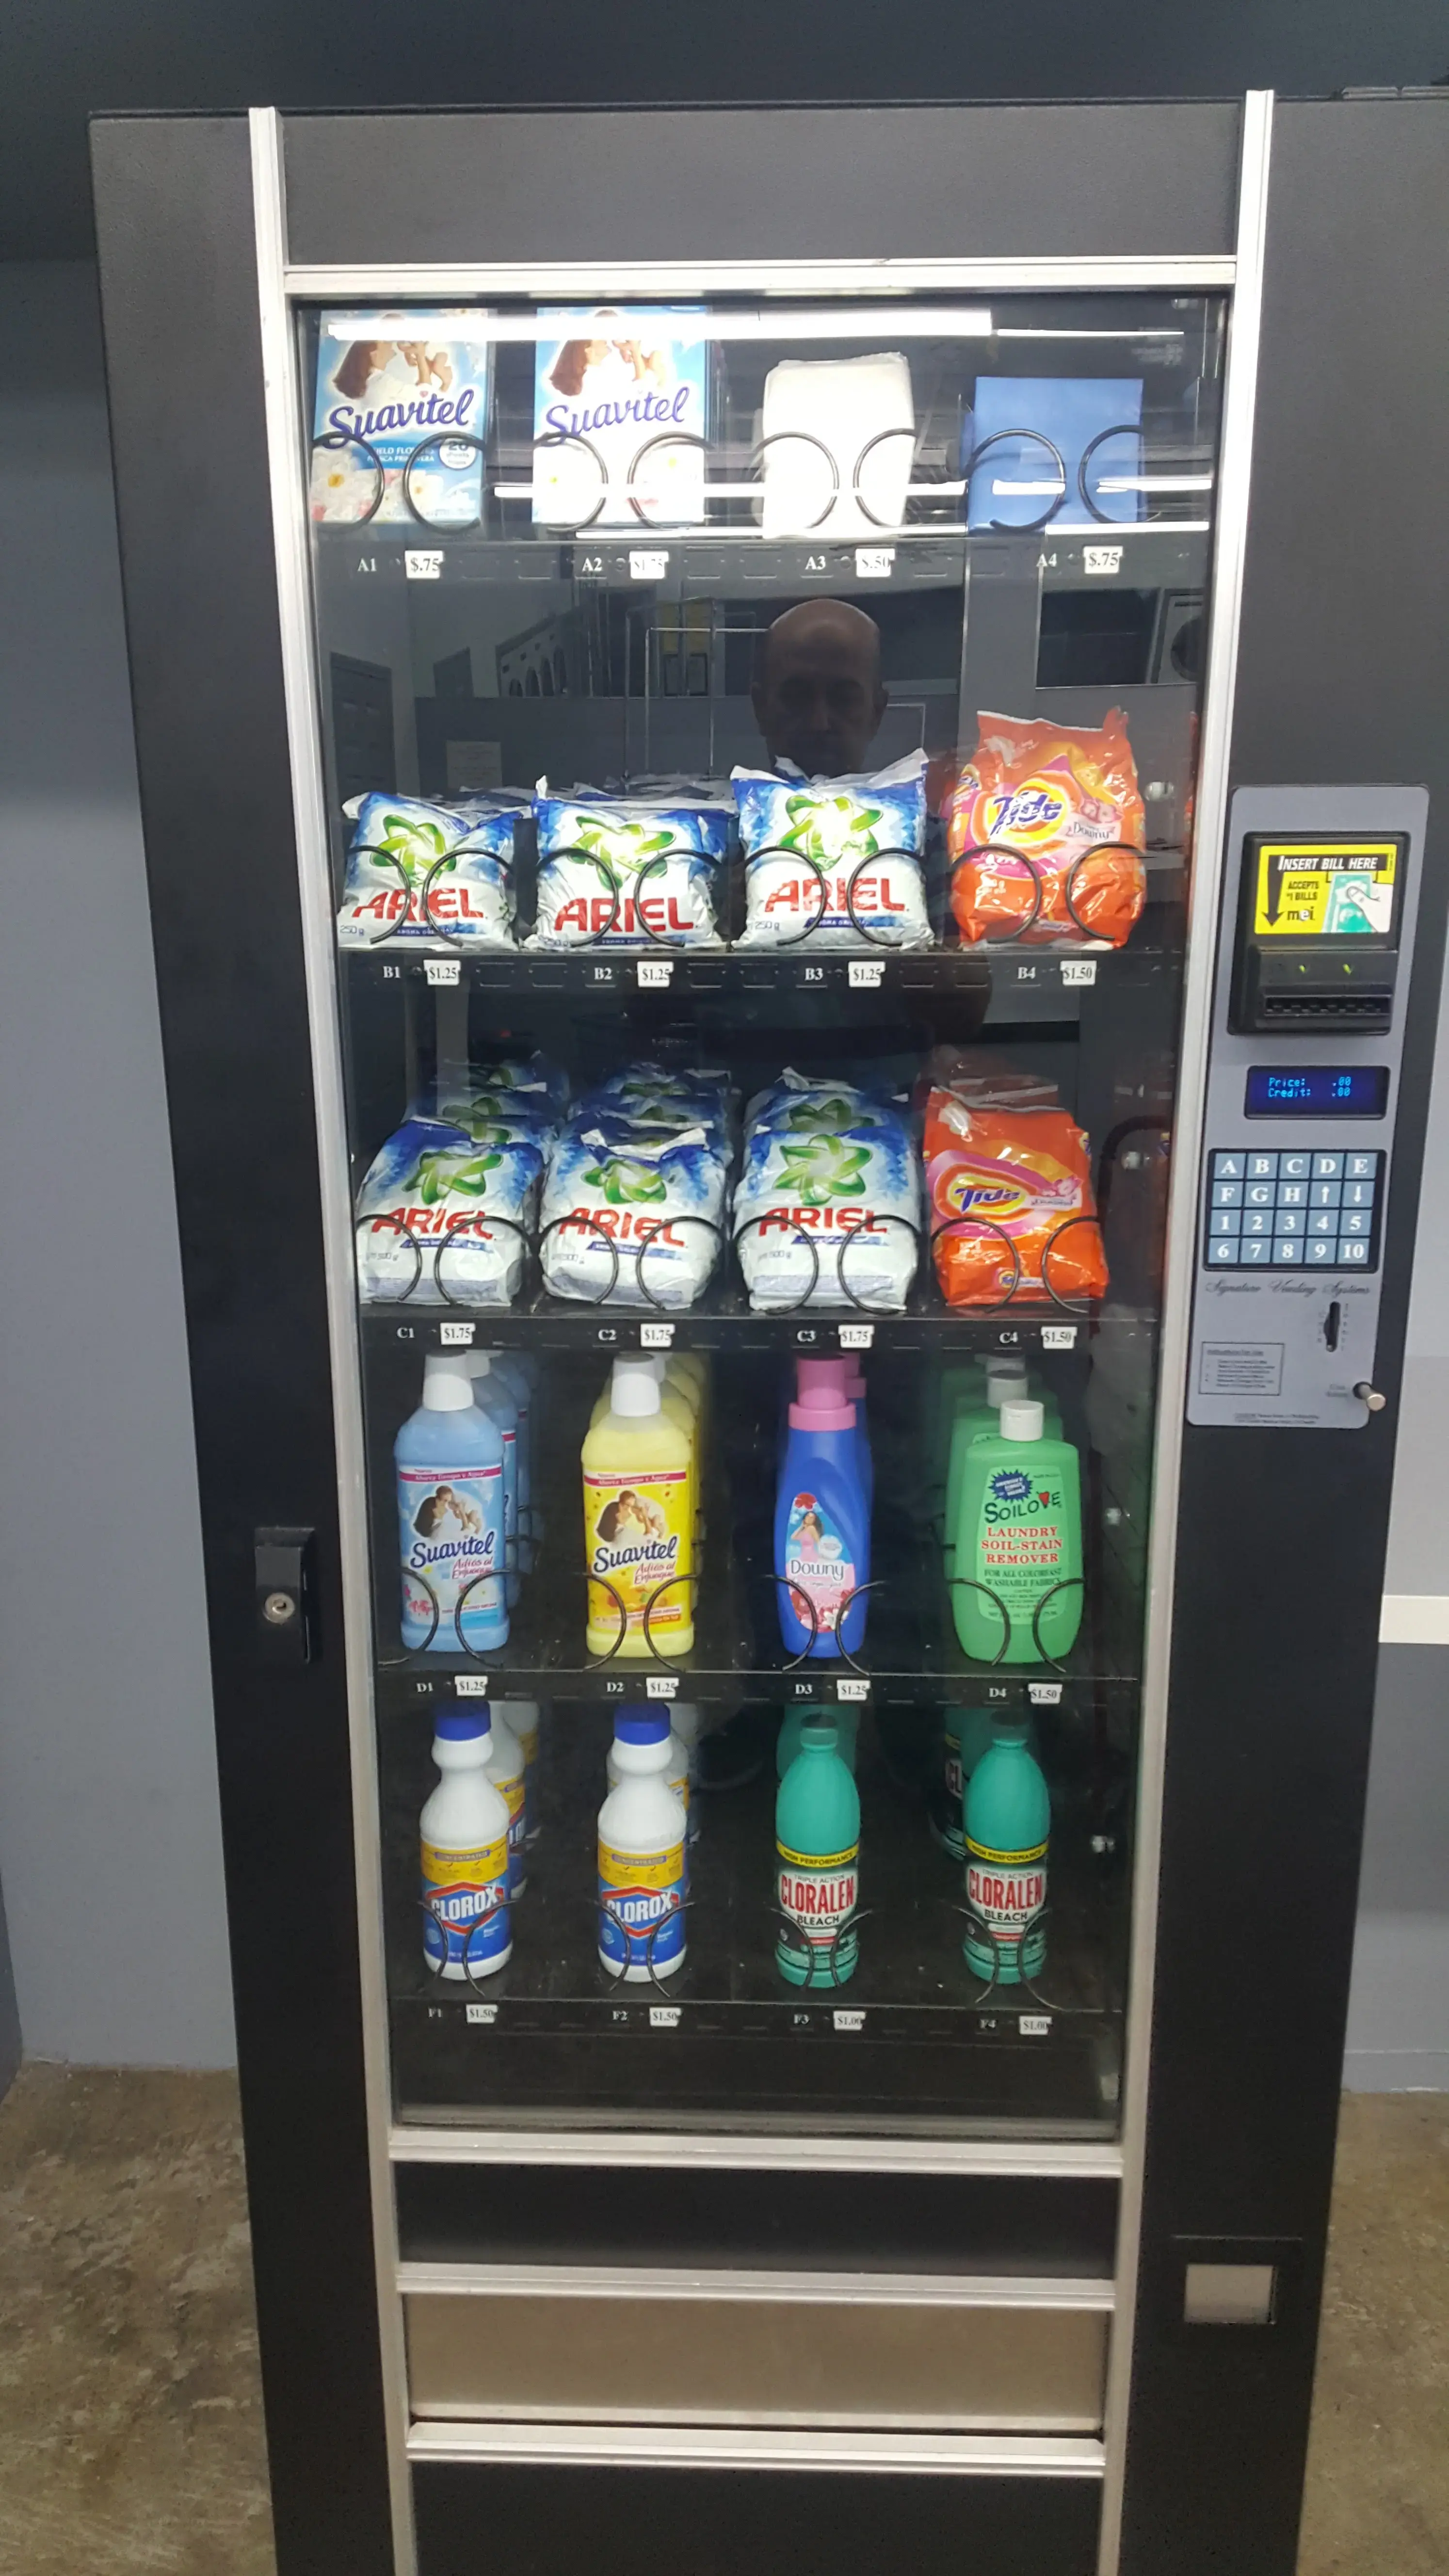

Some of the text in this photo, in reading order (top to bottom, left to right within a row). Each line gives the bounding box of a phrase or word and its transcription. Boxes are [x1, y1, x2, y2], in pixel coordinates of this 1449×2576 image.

[322, 388, 474, 449] Suavitel
[540, 386, 690, 447] Suavitel
[357, 557, 377, 572] A1
[410, 557, 439, 572] $.75
[582, 557, 602, 572] A2
[805, 555, 826, 570] A3
[1036, 552, 1057, 567] A4
[1088, 552, 1118, 567] $.75
[990, 791, 1063, 837] Tide
[1277, 855, 1319, 870] INSERT
[1321, 857, 1344, 869] BILL
[1349, 857, 1378, 869] HERE
[1288, 881, 1320, 890] ACCEPTS
[765, 878, 905, 912] ARIEL
[1295, 891, 1318, 901] BILLS
[352, 888, 483, 922] ARIEL
[554, 897, 693, 933] ARIEL
[1287, 906, 1314, 921] mei
[755, 920, 772, 930] 250
[383, 966, 401, 979] B1
[429, 967, 457, 980] $1.25
[594, 967, 612, 980] B2
[642, 968, 670, 982] $1.25
[805, 967, 823, 981] B3
[853, 968, 881, 982] $1.25
[1017, 966, 1036, 980] B4
[1063, 967, 1093, 980] $1.50
[1269, 1076, 1352, 1087] Price: .00
[1268, 1087, 1351, 1098] Credit: .00
[1220, 1158, 1368, 1174] A B C D E
[954, 1188, 1020, 1213] Tide
[1221, 1187, 1301, 1202] F G H
[372, 1207, 494, 1240] ARIEL
[559, 1207, 685, 1247] ARIEL
[759, 1207, 887, 1237] ARIEL
[1222, 1215, 1362, 1230] 1 2 3 4 5
[1217, 1243, 1364, 1258] 6 7 8 9 10
[396, 1327, 415, 1338] C1
[444, 1328, 471, 1339] $1.75
[598, 1329, 617, 1341] C2
[644, 1329, 671, 1341] $1.75
[797, 1330, 817, 1342] C3
[841, 1331, 868, 1342] $1.75
[999, 1331, 1018, 1343] C4
[1043, 1331, 1072, 1343] $1.50
[987, 1527, 1058, 1537] LAUNDRY
[410, 1531, 494, 1568] Suavitel
[981, 1539, 1063, 1550] SOIL-STAIN
[594, 1536, 677, 1573] Suavitel
[986, 1553, 1059, 1563] REMOVER
[791, 1560, 844, 1581] Downy
[416, 1682, 433, 1692] D1
[459, 1681, 484, 1691] $1.25
[607, 1682, 625, 1692] D2
[650, 1683, 676, 1693] $1.25
[795, 1684, 813, 1694] D3
[841, 1685, 867, 1695] $1.25
[989, 1688, 1007, 1697] D4
[1031, 1689, 1057, 1699] $1.50
[795, 1874, 844, 1883] TRIPLE ACTION
[782, 1874, 854, 1914] CLORALEN
[969, 1868, 1042, 1911] CLORALEN
[431, 1884, 498, 1921] CLOROX
[606, 1890, 672, 1923] CLOROX
[797, 1914, 839, 1926] BLEACH
[984, 1909, 1028, 1921] BLEACH
[469, 2009, 494, 2018] $1.50
[612, 2011, 628, 2021] F2
[653, 2012, 677, 2021] $1.50
[837, 2016, 861, 2026] $1.00
[1023, 2020, 1048, 2030] $1.00
